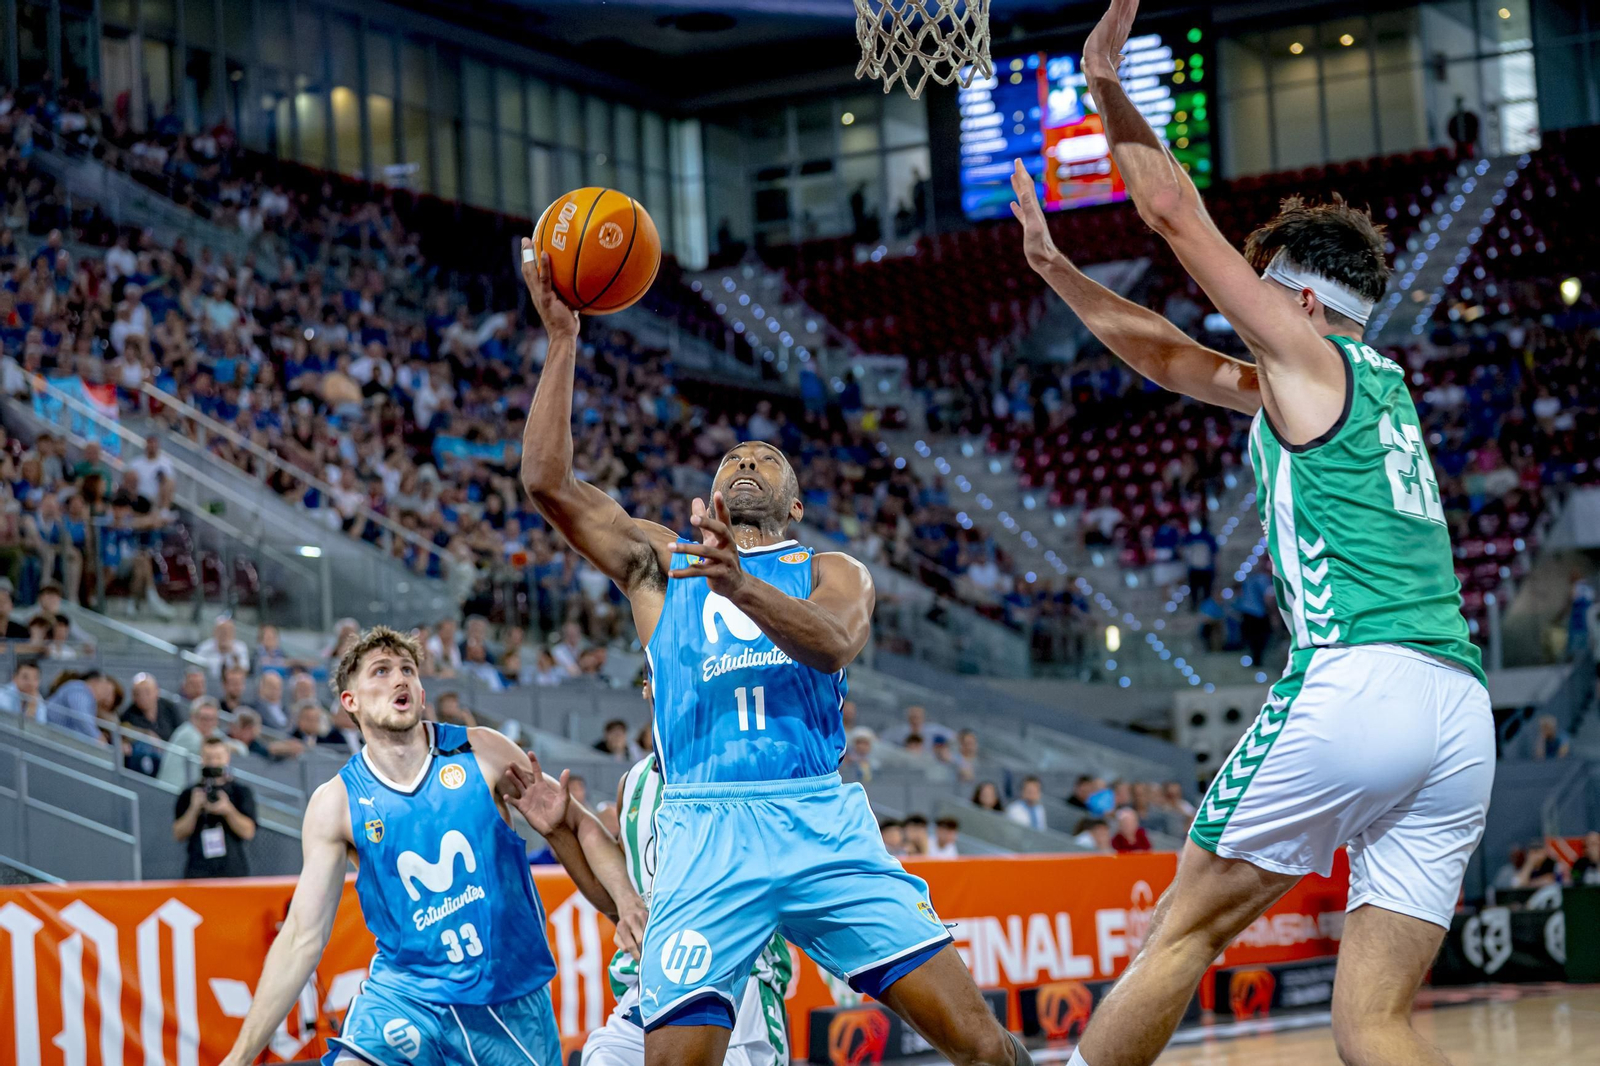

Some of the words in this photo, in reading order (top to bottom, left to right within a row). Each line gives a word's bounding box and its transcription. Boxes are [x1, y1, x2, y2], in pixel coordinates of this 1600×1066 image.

[551, 201, 578, 252] EVO
[734, 686, 766, 731] 11
[412, 884, 486, 932] Estudiantes
[440, 922, 484, 963] 33
[662, 929, 711, 985] hp
[384, 1018, 420, 1059] hp
